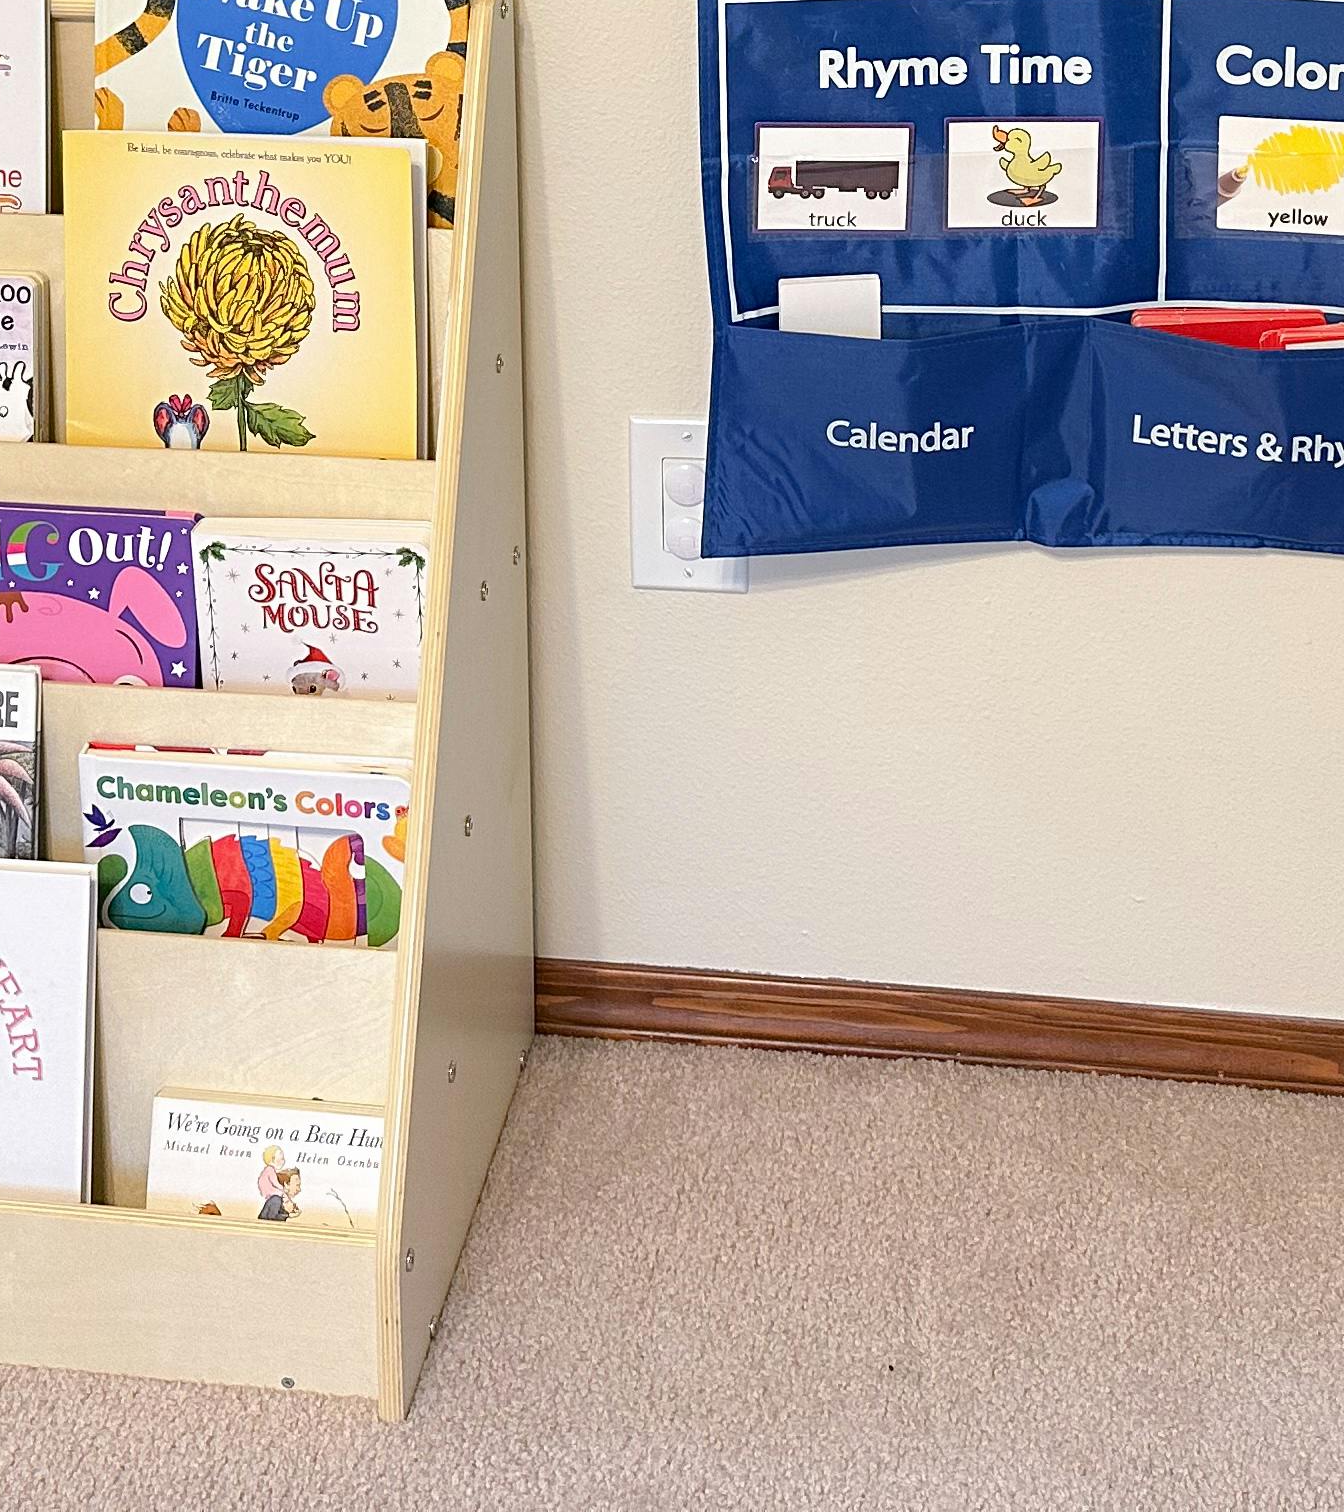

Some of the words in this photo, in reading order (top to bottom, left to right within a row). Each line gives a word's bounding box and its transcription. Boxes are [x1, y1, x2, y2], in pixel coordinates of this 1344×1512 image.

[245, 22, 295, 54] the
[196, 33, 318, 93] Tiger
[818, 50, 967, 97] Rhyme
[980, 44, 1092, 86] Time
[808, 211, 856, 229] truck
[1001, 210, 1047, 228] duck
[1267, 208, 1328, 229] yellow
[108, 170, 360, 333] Chrysanthemum
[826, 419, 974, 455] Calendar
[1132, 415, 1248, 458] Letters
[1256, 433, 1283, 461] &
[68, 527, 173, 572] out!
[248, 562, 379, 608] SANTA
[262, 605, 379, 635] MOUSE
[96, 776, 288, 812] Chameleon's
[295, 791, 391, 820] Colors
[167, 1112, 209, 1135] We're
[215, 1117, 261, 1143] Going
[266, 1128, 284, 1141] on
[290, 1129, 299, 1141] a
[305, 1124, 343, 1145] Bear
[347, 1128, 382, 1148] Hun
